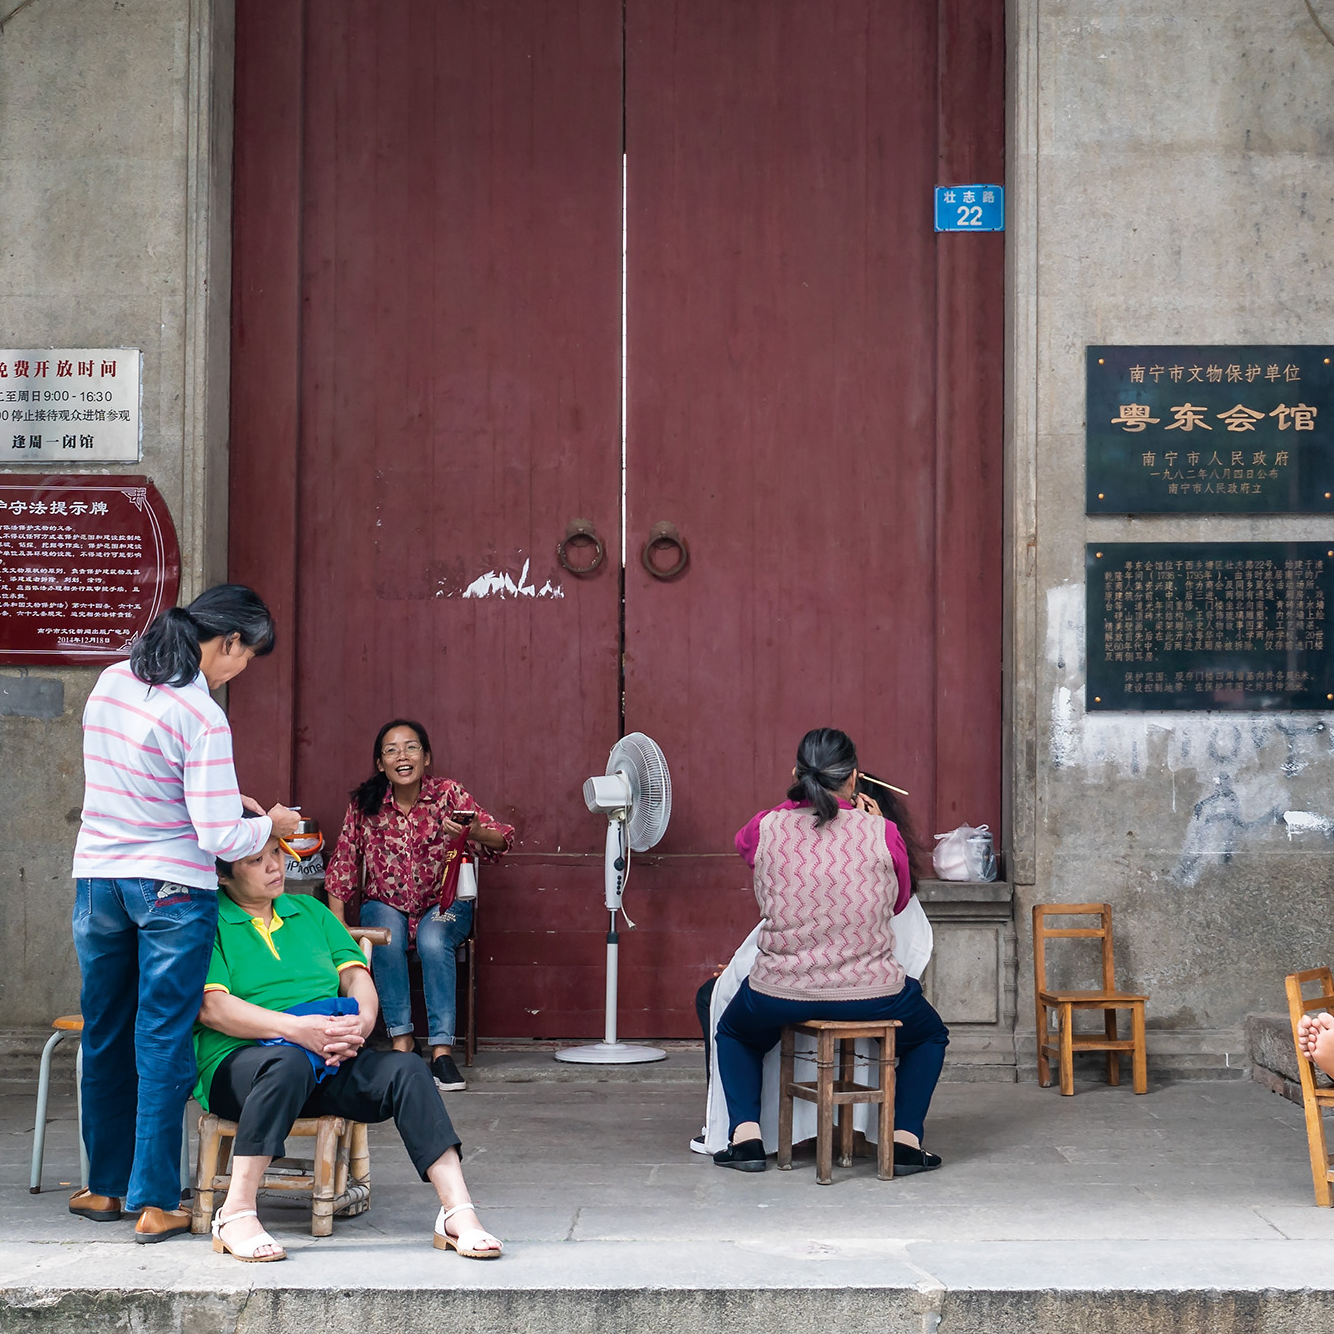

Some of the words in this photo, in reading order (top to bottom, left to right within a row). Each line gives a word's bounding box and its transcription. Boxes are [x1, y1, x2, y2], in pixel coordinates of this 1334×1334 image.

[943, 190, 995, 203] 壮志路
[957, 206, 982, 226] 22
[1129, 364, 1301, 383] 南宁市文物保护单位
[1111, 402, 1318, 433] 粤东会馆
[11, 434, 95, 449] 逢周一闭馆
[1142, 450, 1289, 466] 南宁市人民政府
[1168, 483, 1263, 495] 南宁市人民政府立
[57, 636, 110, 644] 2014年12月18日
